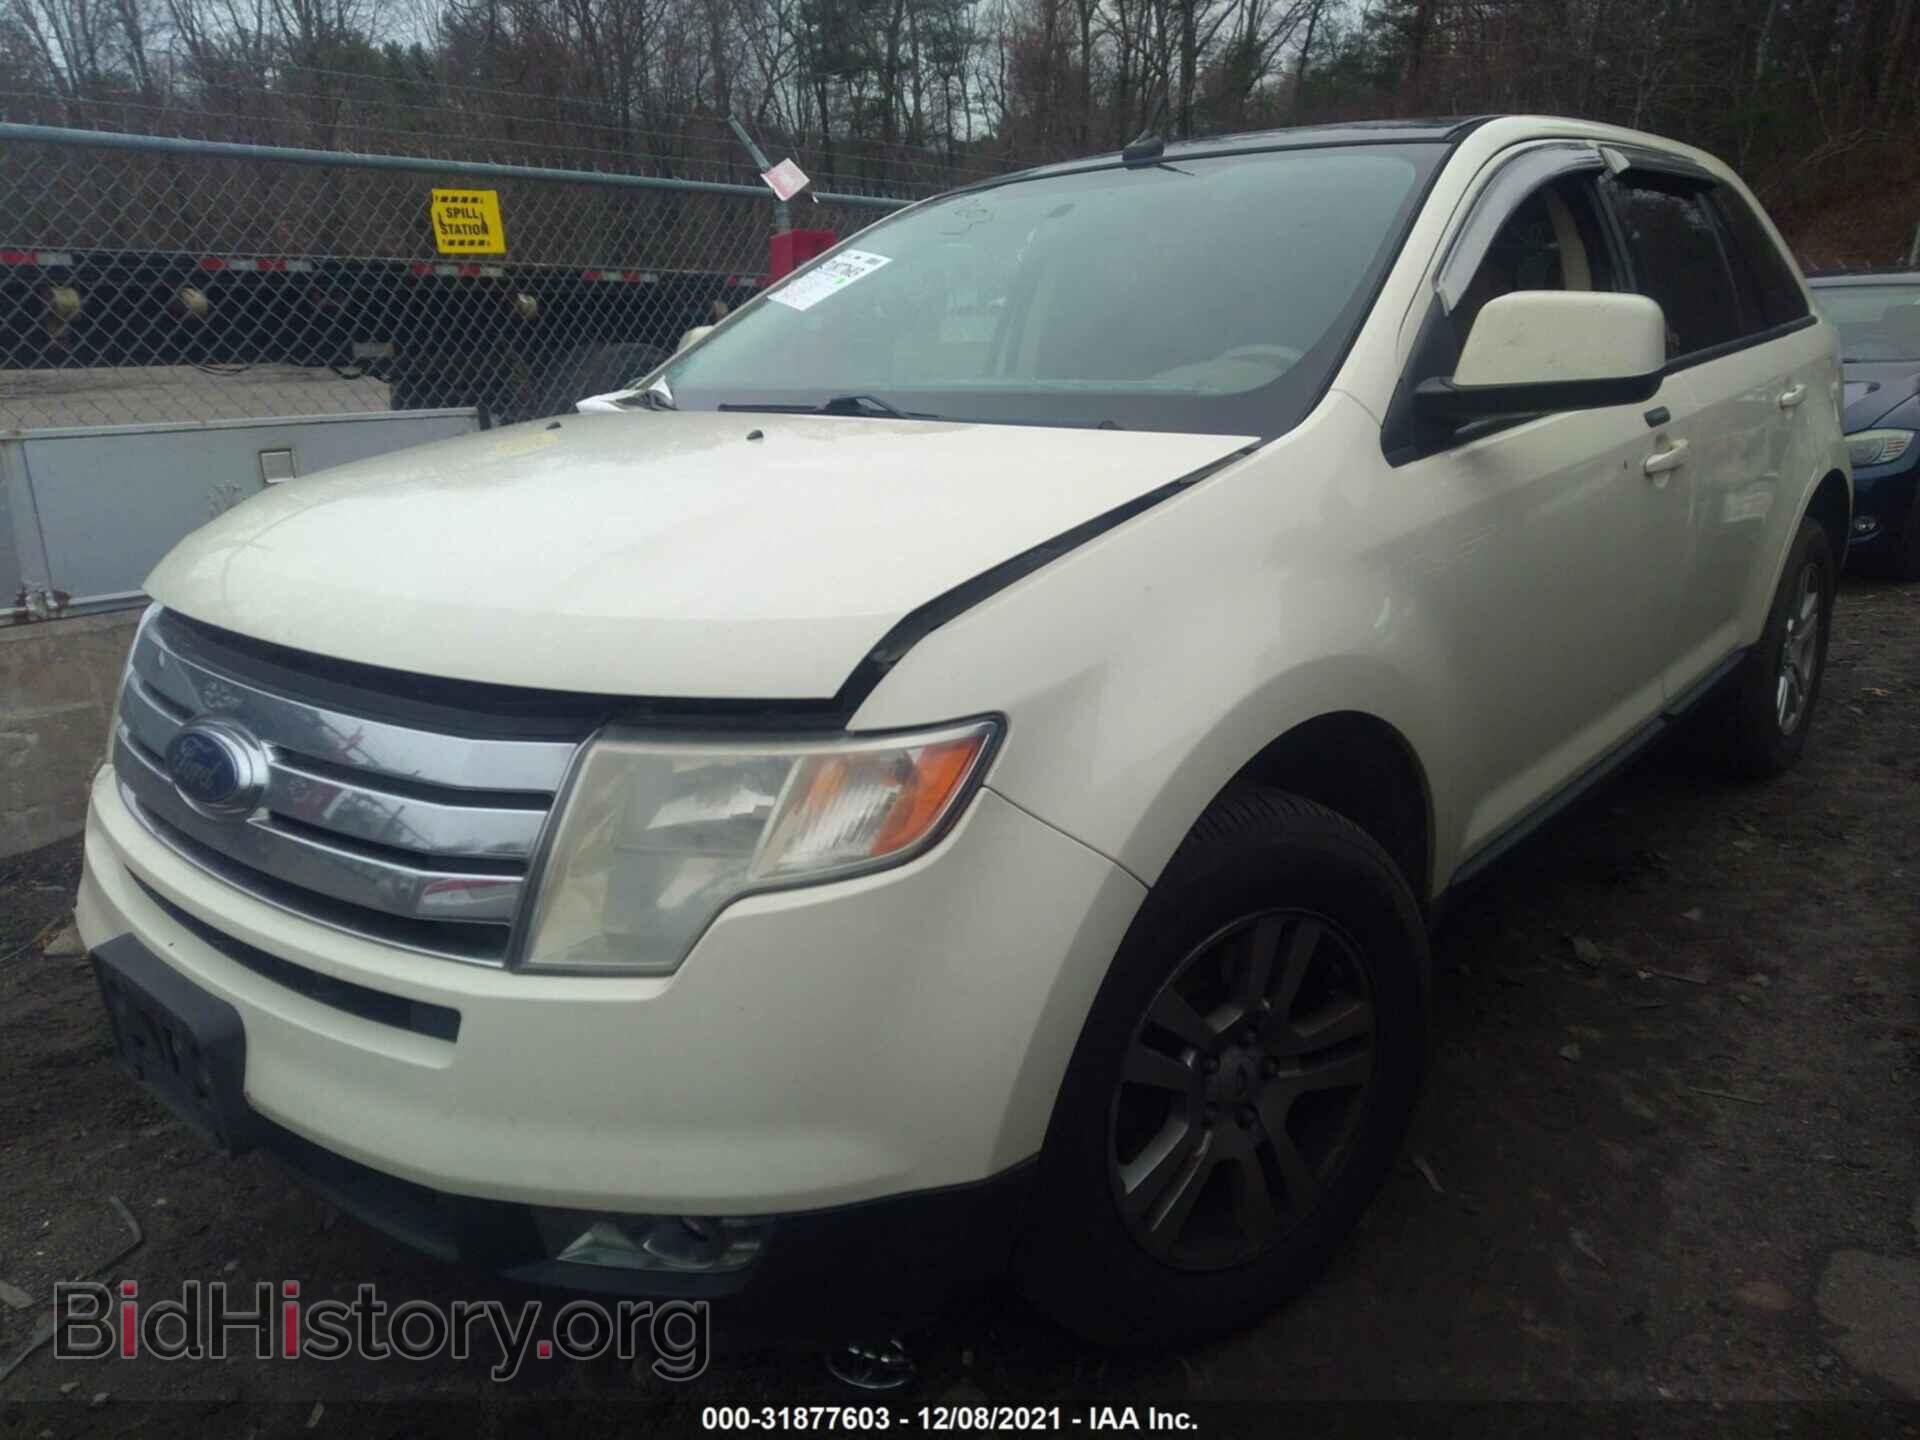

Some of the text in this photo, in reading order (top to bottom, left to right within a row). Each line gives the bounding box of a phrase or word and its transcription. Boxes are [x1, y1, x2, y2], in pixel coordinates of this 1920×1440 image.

[446, 207, 479, 219] SPILL
[440, 224, 489, 236] STATION
[173, 735, 223, 788] Ford
